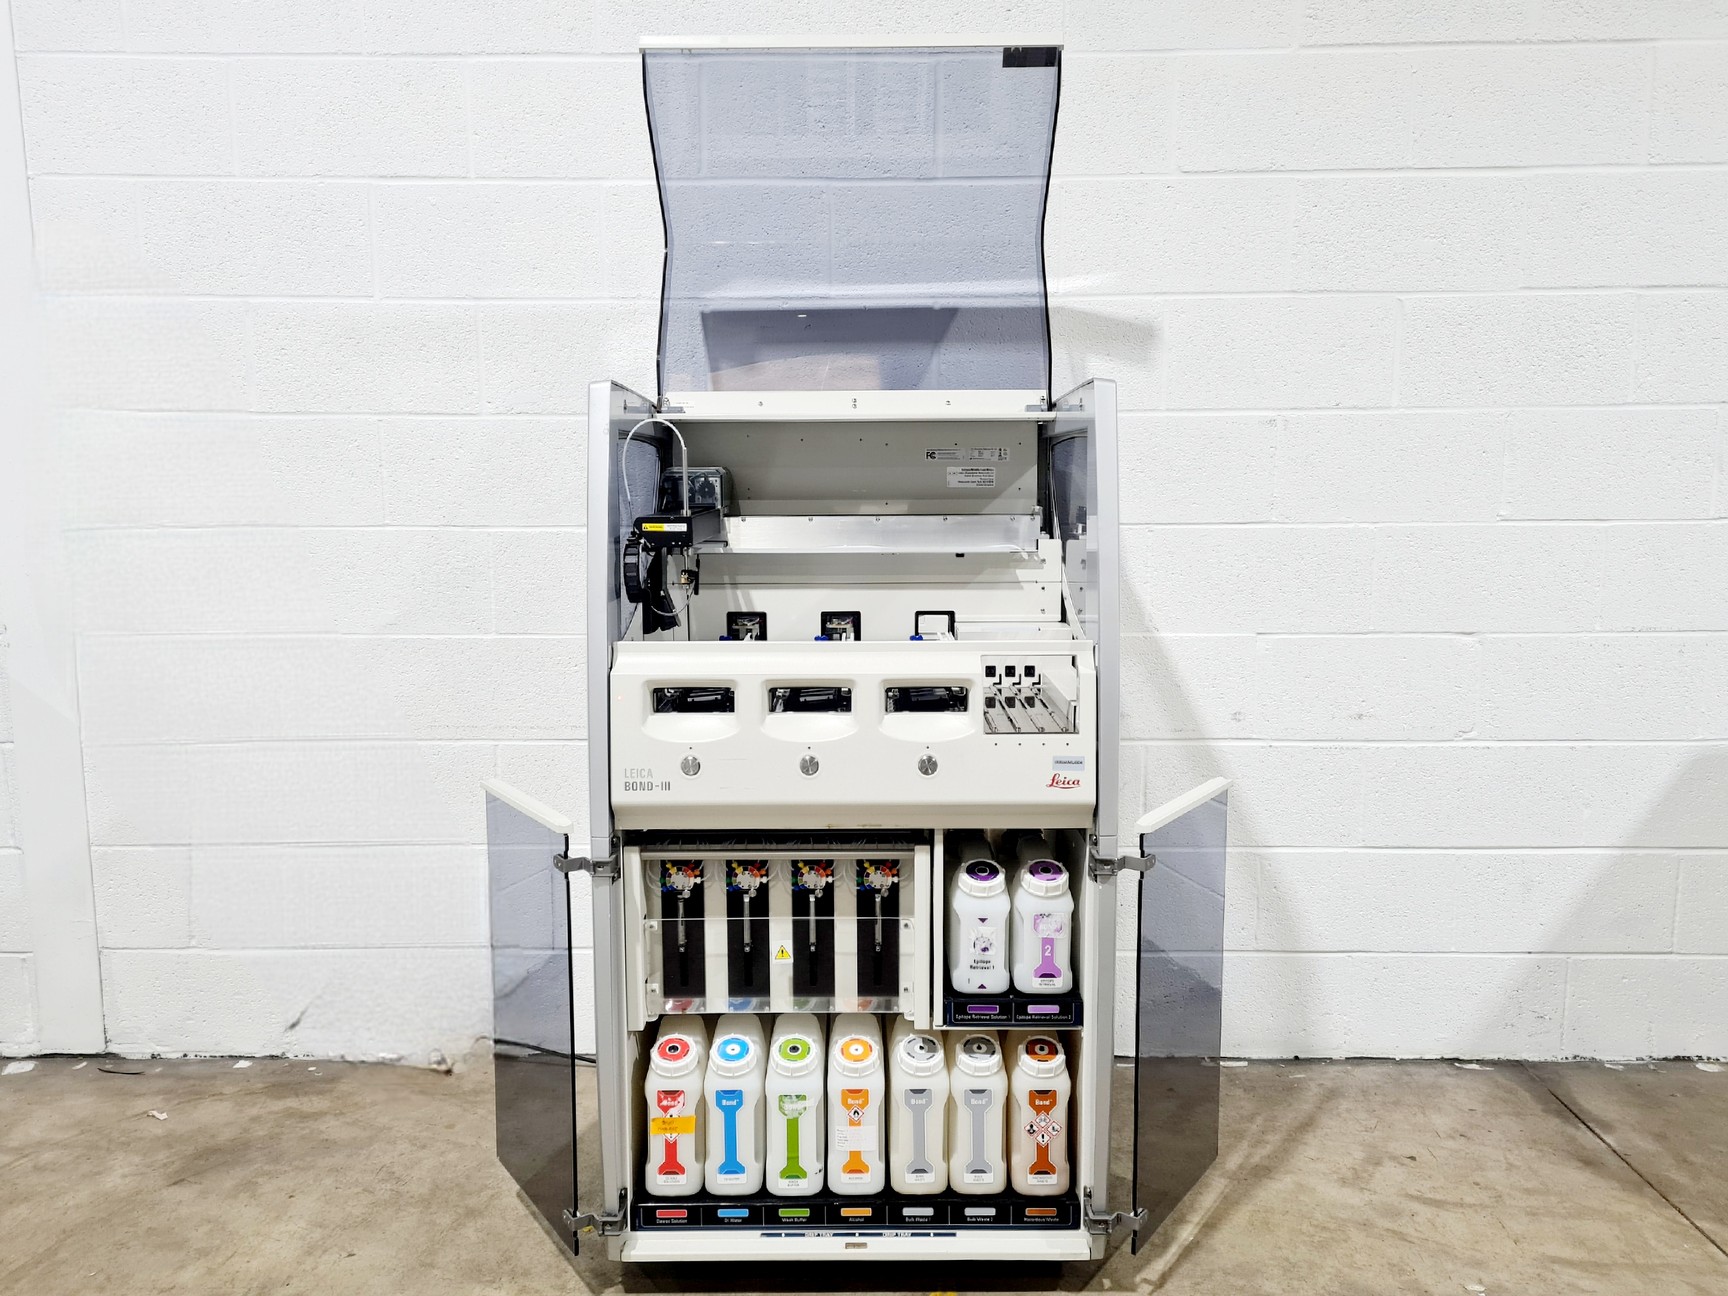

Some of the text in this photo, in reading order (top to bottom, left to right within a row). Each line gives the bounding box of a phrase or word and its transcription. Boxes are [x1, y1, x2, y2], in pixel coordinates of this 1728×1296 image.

[624, 768, 654, 779] LEICA
[624, 781, 671, 791] BOND-III
[1046, 772, 1081, 789] Leica
[1044, 945, 1052, 956] 2
